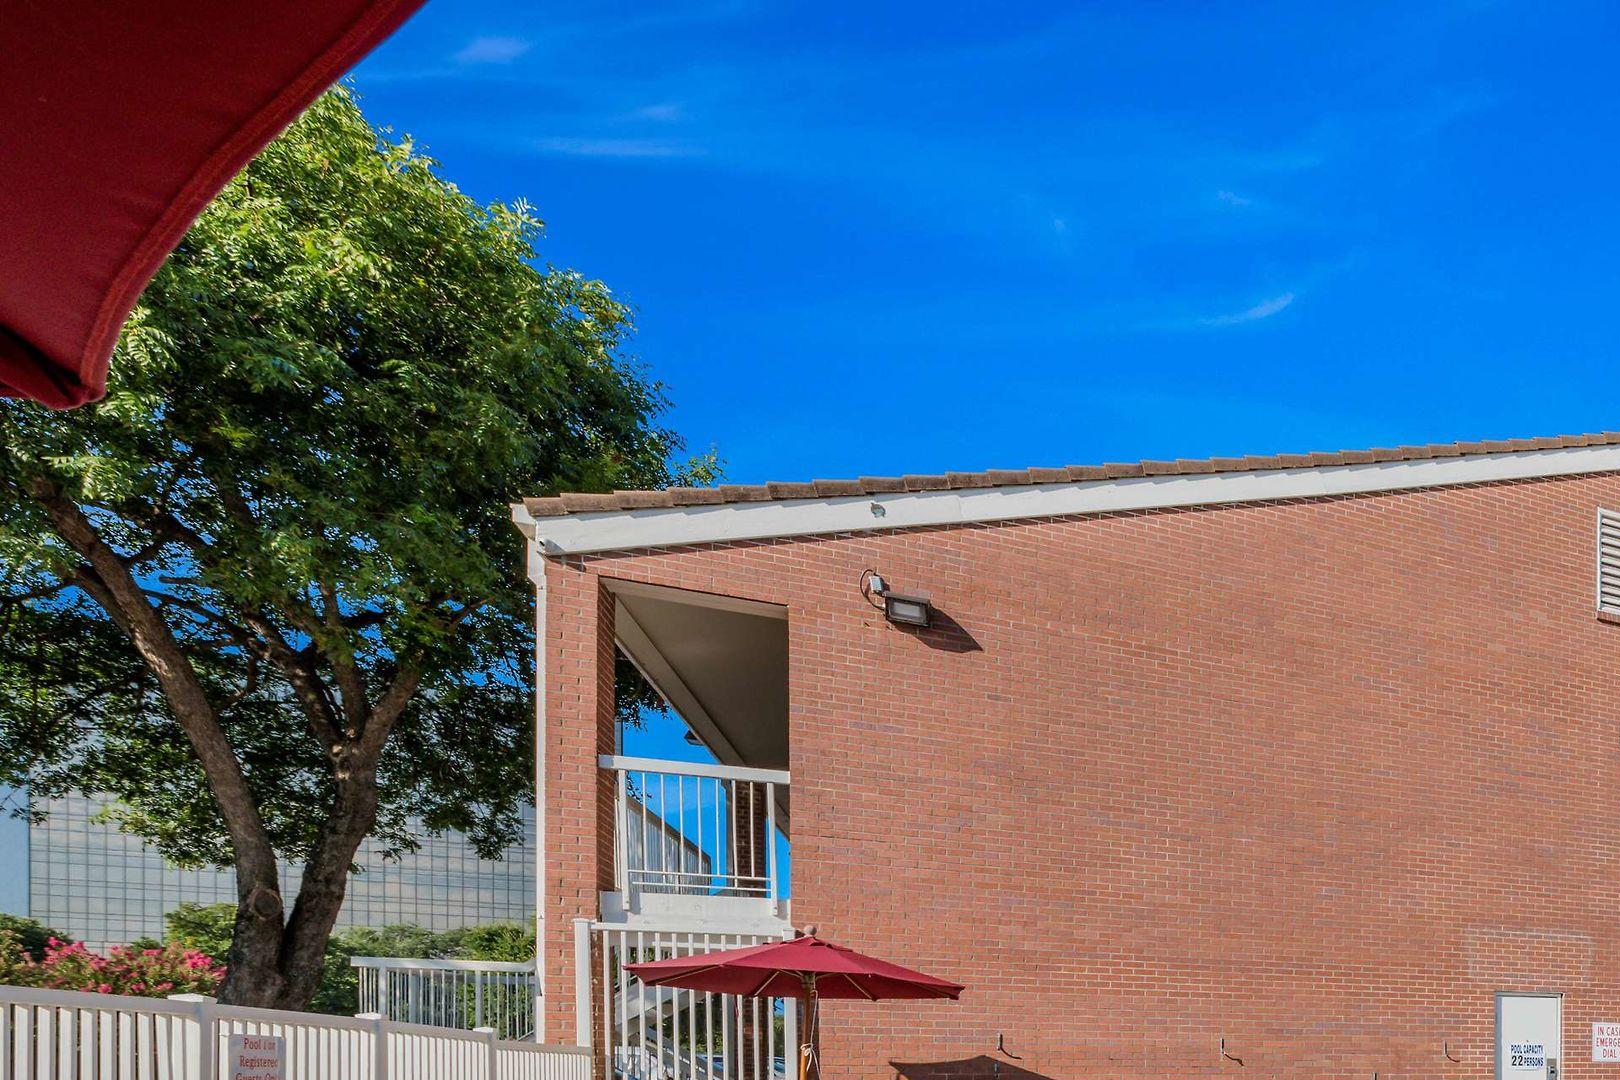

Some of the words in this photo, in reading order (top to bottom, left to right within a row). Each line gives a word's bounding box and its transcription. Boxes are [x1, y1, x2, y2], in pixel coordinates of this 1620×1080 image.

[1597, 1026, 1604, 1036] IN
[243, 1037, 261, 1050] Pool
[1510, 1044, 1522, 1054] POOL
[1523, 1044, 1543, 1054] CAPACITY
[1602, 1048, 1616, 1058] DIAL
[1511, 1055, 1523, 1066] 22
[1524, 1057, 1543, 1066] PERSONS
